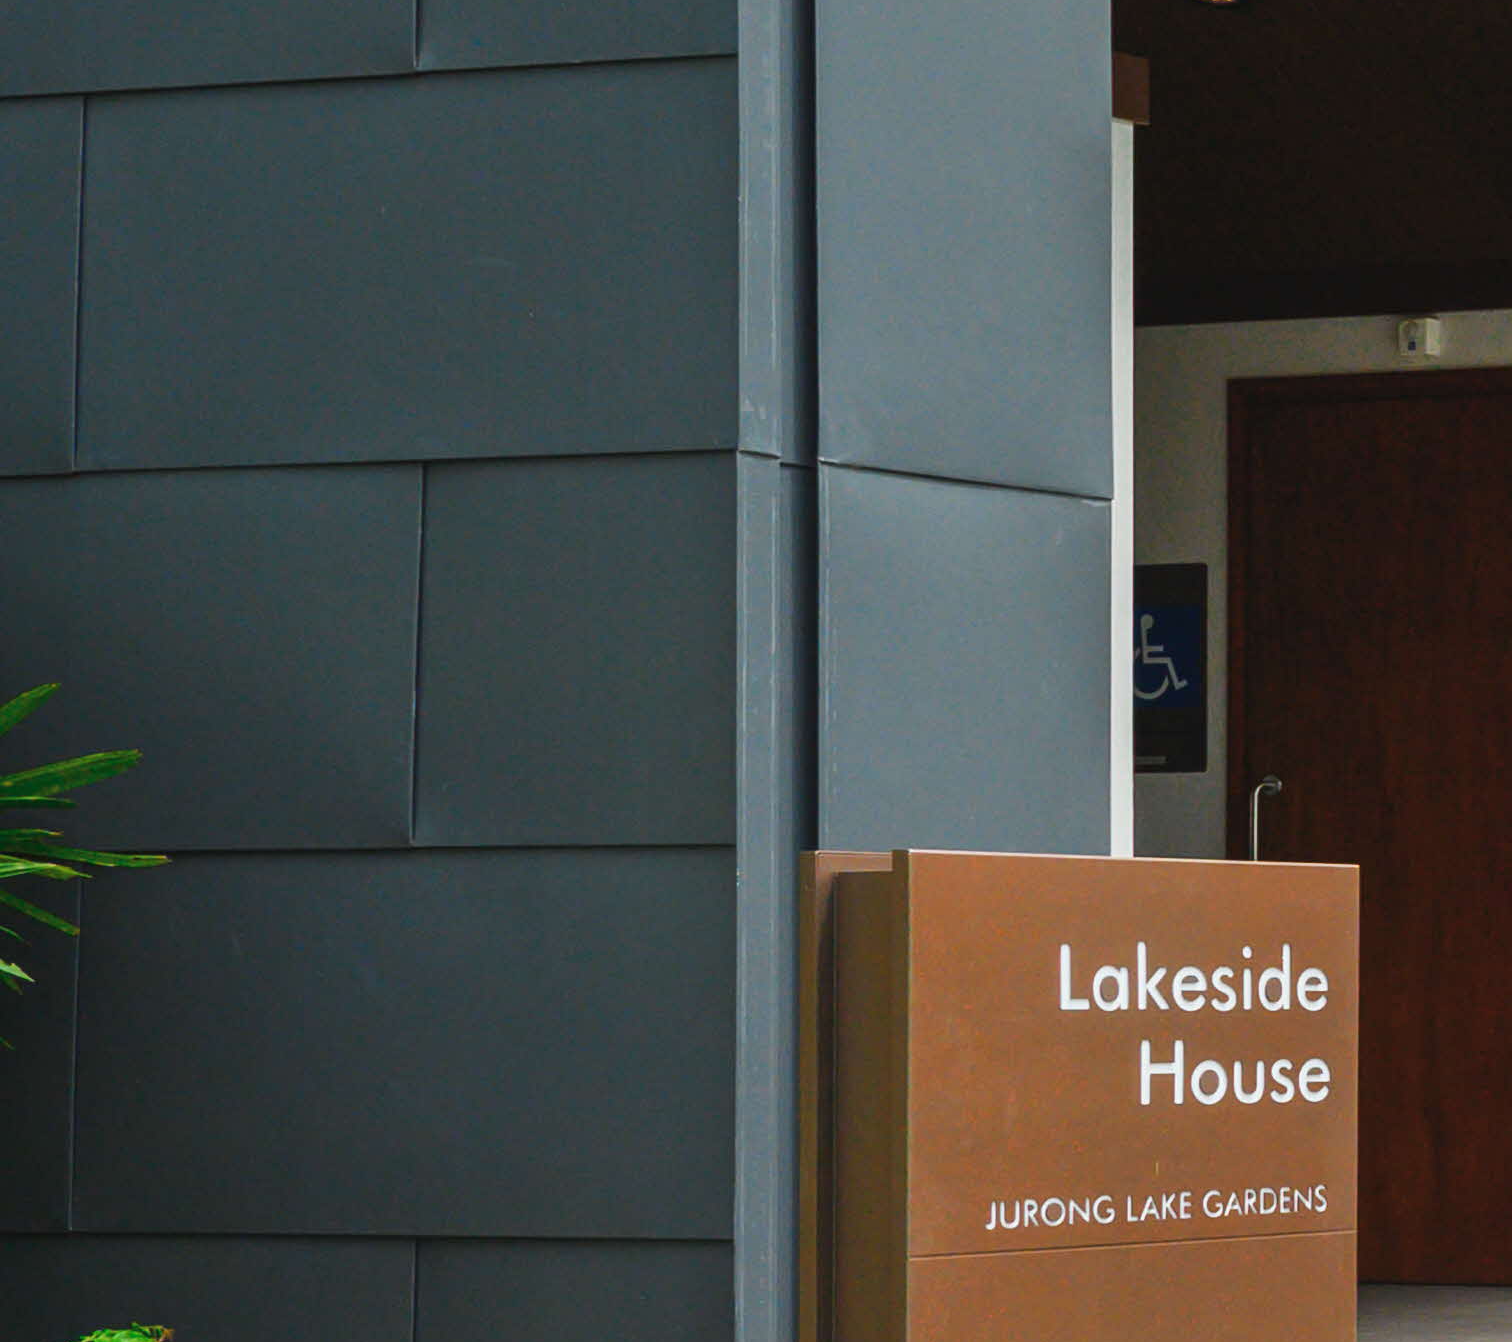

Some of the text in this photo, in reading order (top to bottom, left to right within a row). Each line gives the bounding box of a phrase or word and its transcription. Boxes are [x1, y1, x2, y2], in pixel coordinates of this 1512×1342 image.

[1059, 941, 1330, 1014] Lakeside
[1139, 1039, 1332, 1107] House
[984, 1184, 1329, 1232] JURONG LAKE GARDENS
